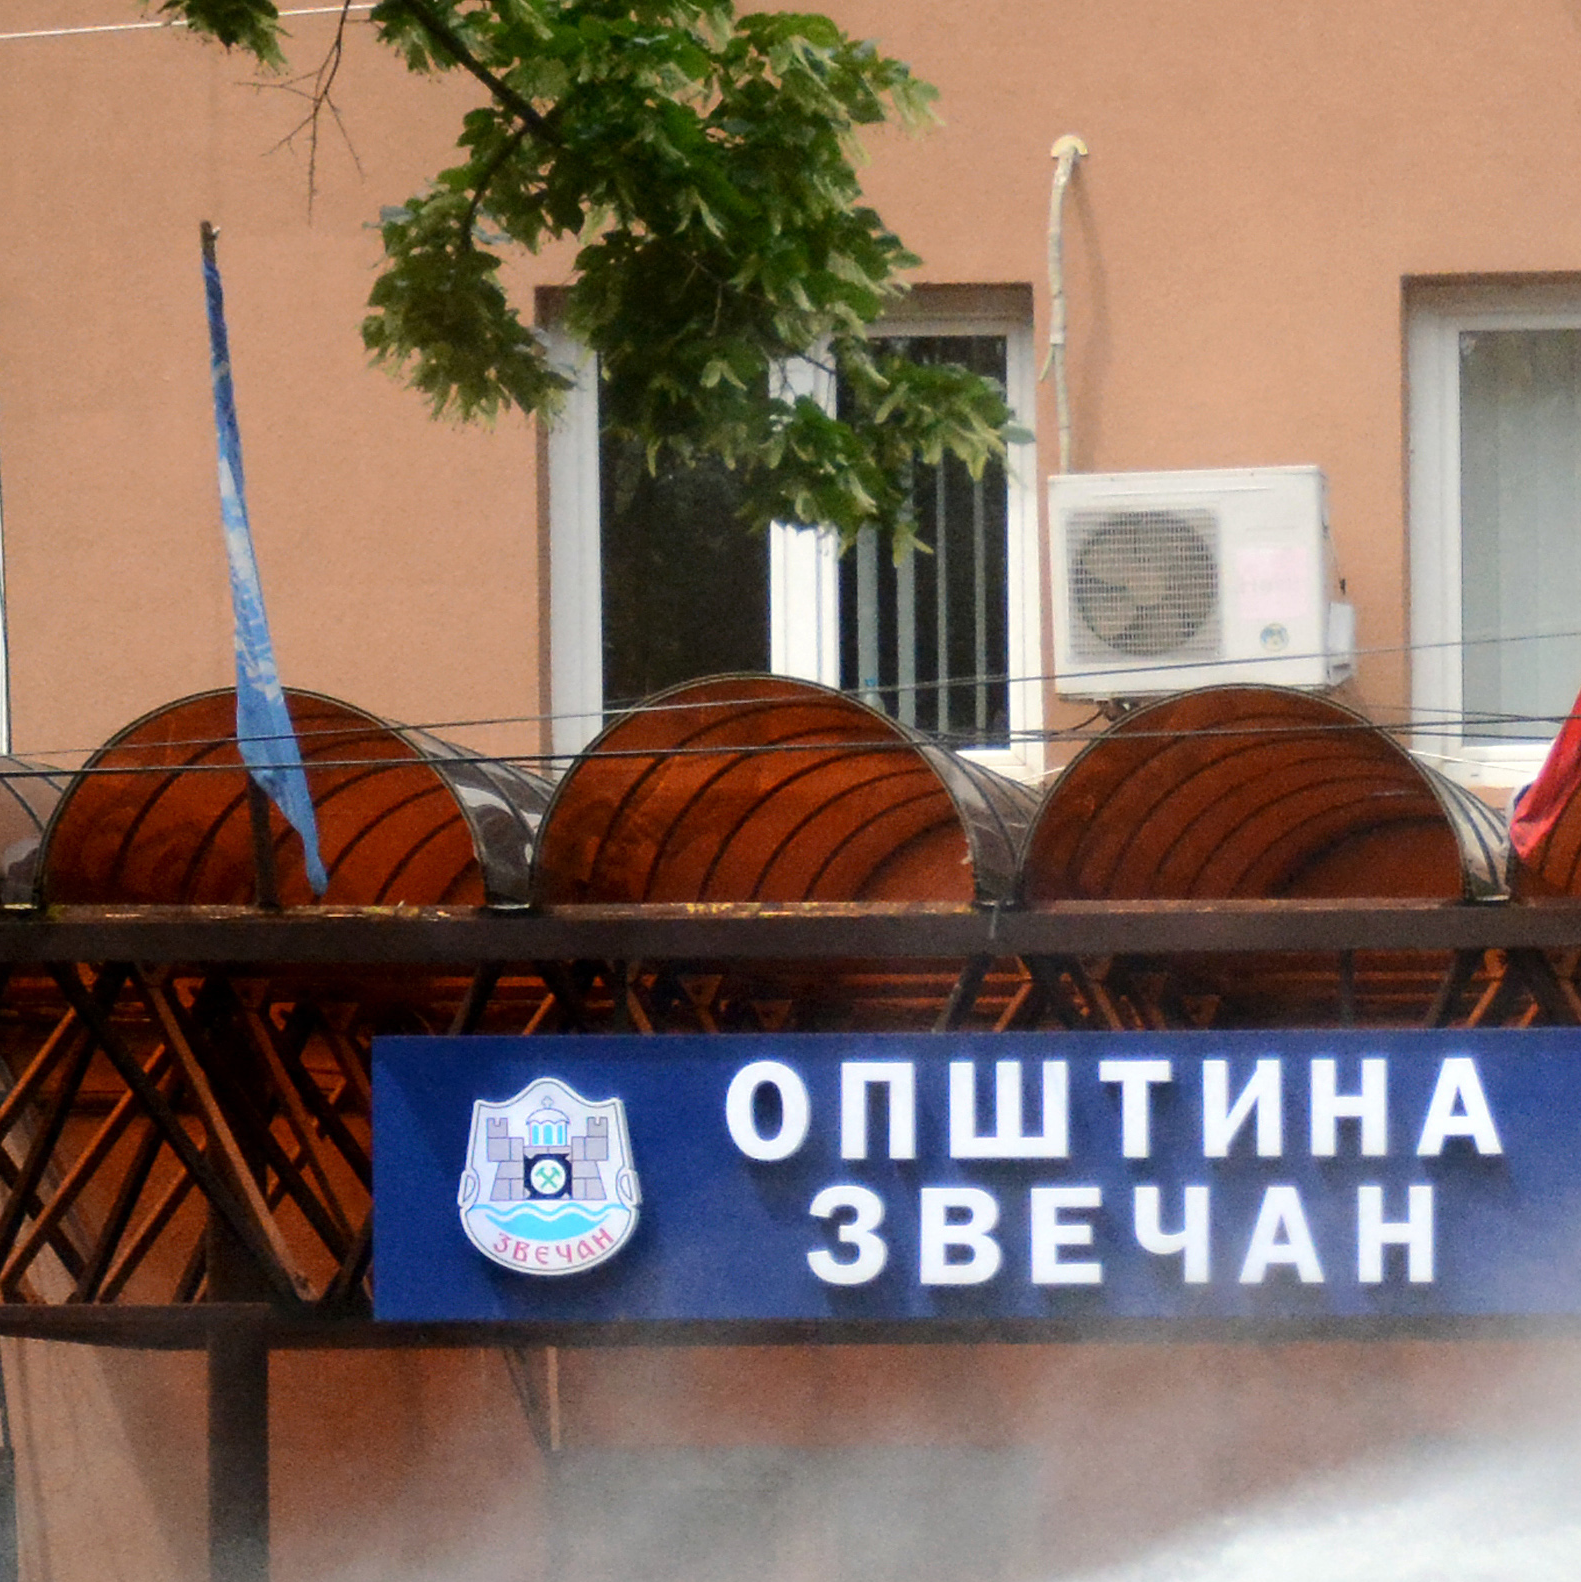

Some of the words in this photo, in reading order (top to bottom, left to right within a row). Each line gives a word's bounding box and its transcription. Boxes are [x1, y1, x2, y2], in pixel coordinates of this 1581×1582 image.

[725, 1056, 1504, 1162] ОПШТИНА
[492, 1228, 614, 1265] ЗВЕЧАН
[807, 1184, 1435, 1286] ЗВЕЧАН
